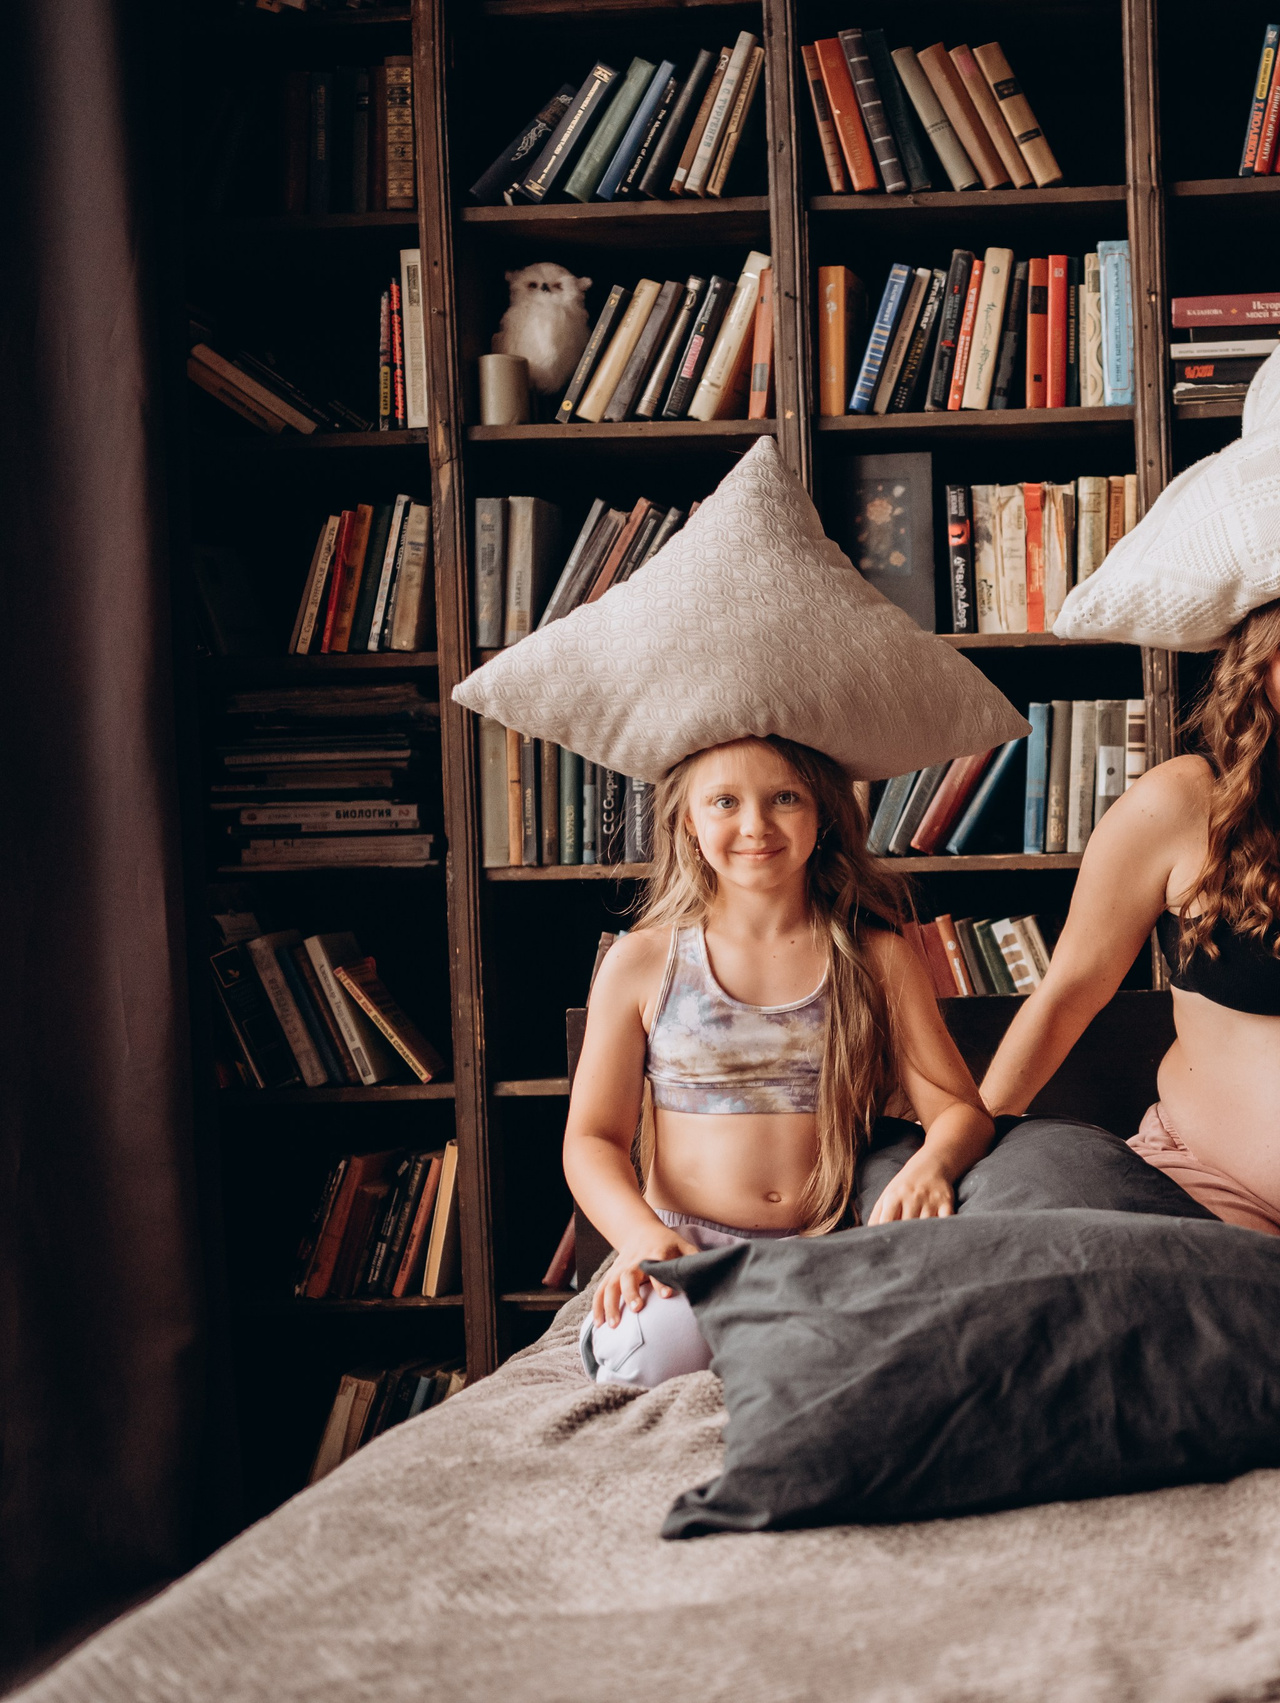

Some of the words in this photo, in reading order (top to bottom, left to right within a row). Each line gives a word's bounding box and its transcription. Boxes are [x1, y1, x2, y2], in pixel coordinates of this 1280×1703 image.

[642, 118, 661, 148] Museums
[702, 95, 727, 148] ТУРГЕНЕВ
[730, 96, 744, 127] МАРИЯ
[1242, 109, 1263, 169] ПОЛЯКОВА
[624, 153, 643, 183] Leningrad
[388, 283, 400, 311] ДНЯ
[918, 302, 933, 329] WARS
[926, 277, 940, 304] STAR
[390, 313, 403, 364] ПЕРВОГО
[958, 335, 971, 386] ПАУСТОВСКИЙ
[393, 368, 405, 419] ПАМЯТЬ
[303, 611, 315, 633] Сухов
[309, 566, 327, 607] ДОНСКАЯ
[320, 525, 337, 565] ПОВЕСТЬ
[317, 962, 338, 1000] Александр
[333, 999, 356, 1043] Твардовский
[345, 981, 363, 1003] РУССКИЙ
[360, 1000, 373, 1014] ЯЗЫК
[371, 1013, 395, 1041] ПОЛНЫЙ
[391, 1038, 424, 1078] СПРАВОЧНИК
